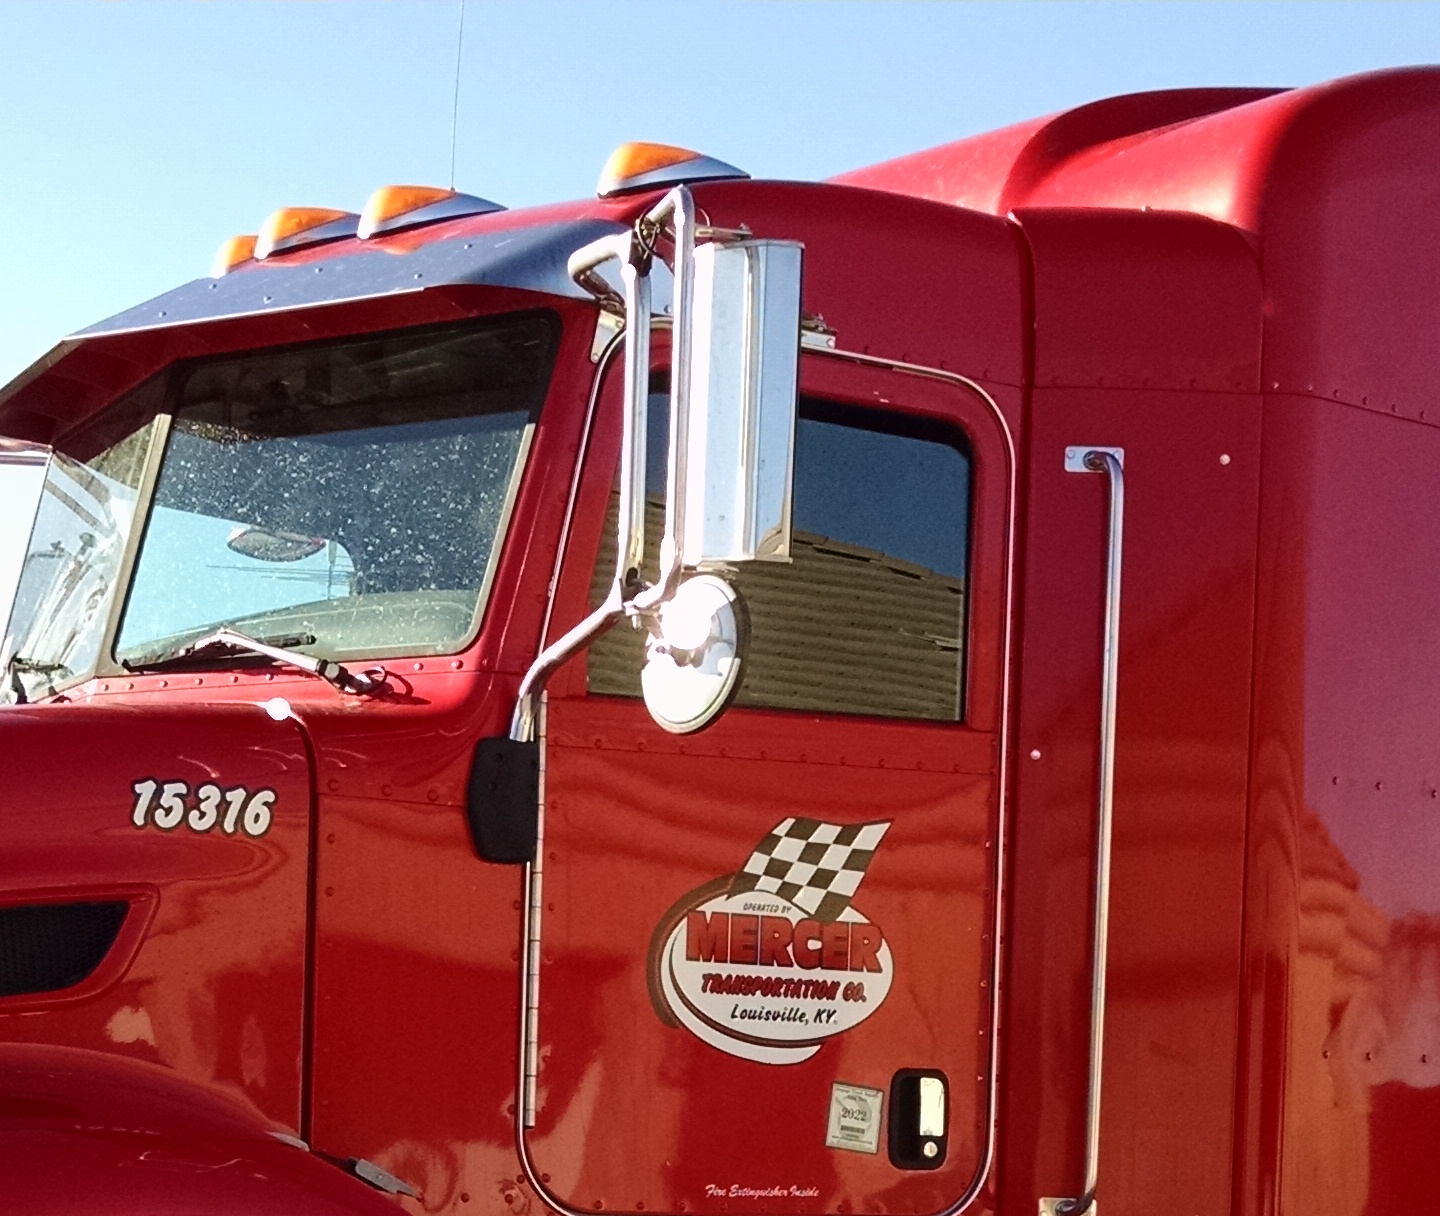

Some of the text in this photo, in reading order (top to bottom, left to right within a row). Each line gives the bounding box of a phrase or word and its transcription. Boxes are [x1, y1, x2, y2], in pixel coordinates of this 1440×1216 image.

[132, 779, 277, 837] 15316
[743, 902, 792, 914] OPERATED BY
[686, 910, 883, 973] MERCER
[701, 973, 867, 1003] TRANSPORTATION CO.
[731, 1004, 809, 1025] Louisville,
[841, 1107, 867, 1121] 2022
[705, 1184, 820, 1200] Fire Extinguisher Inside
